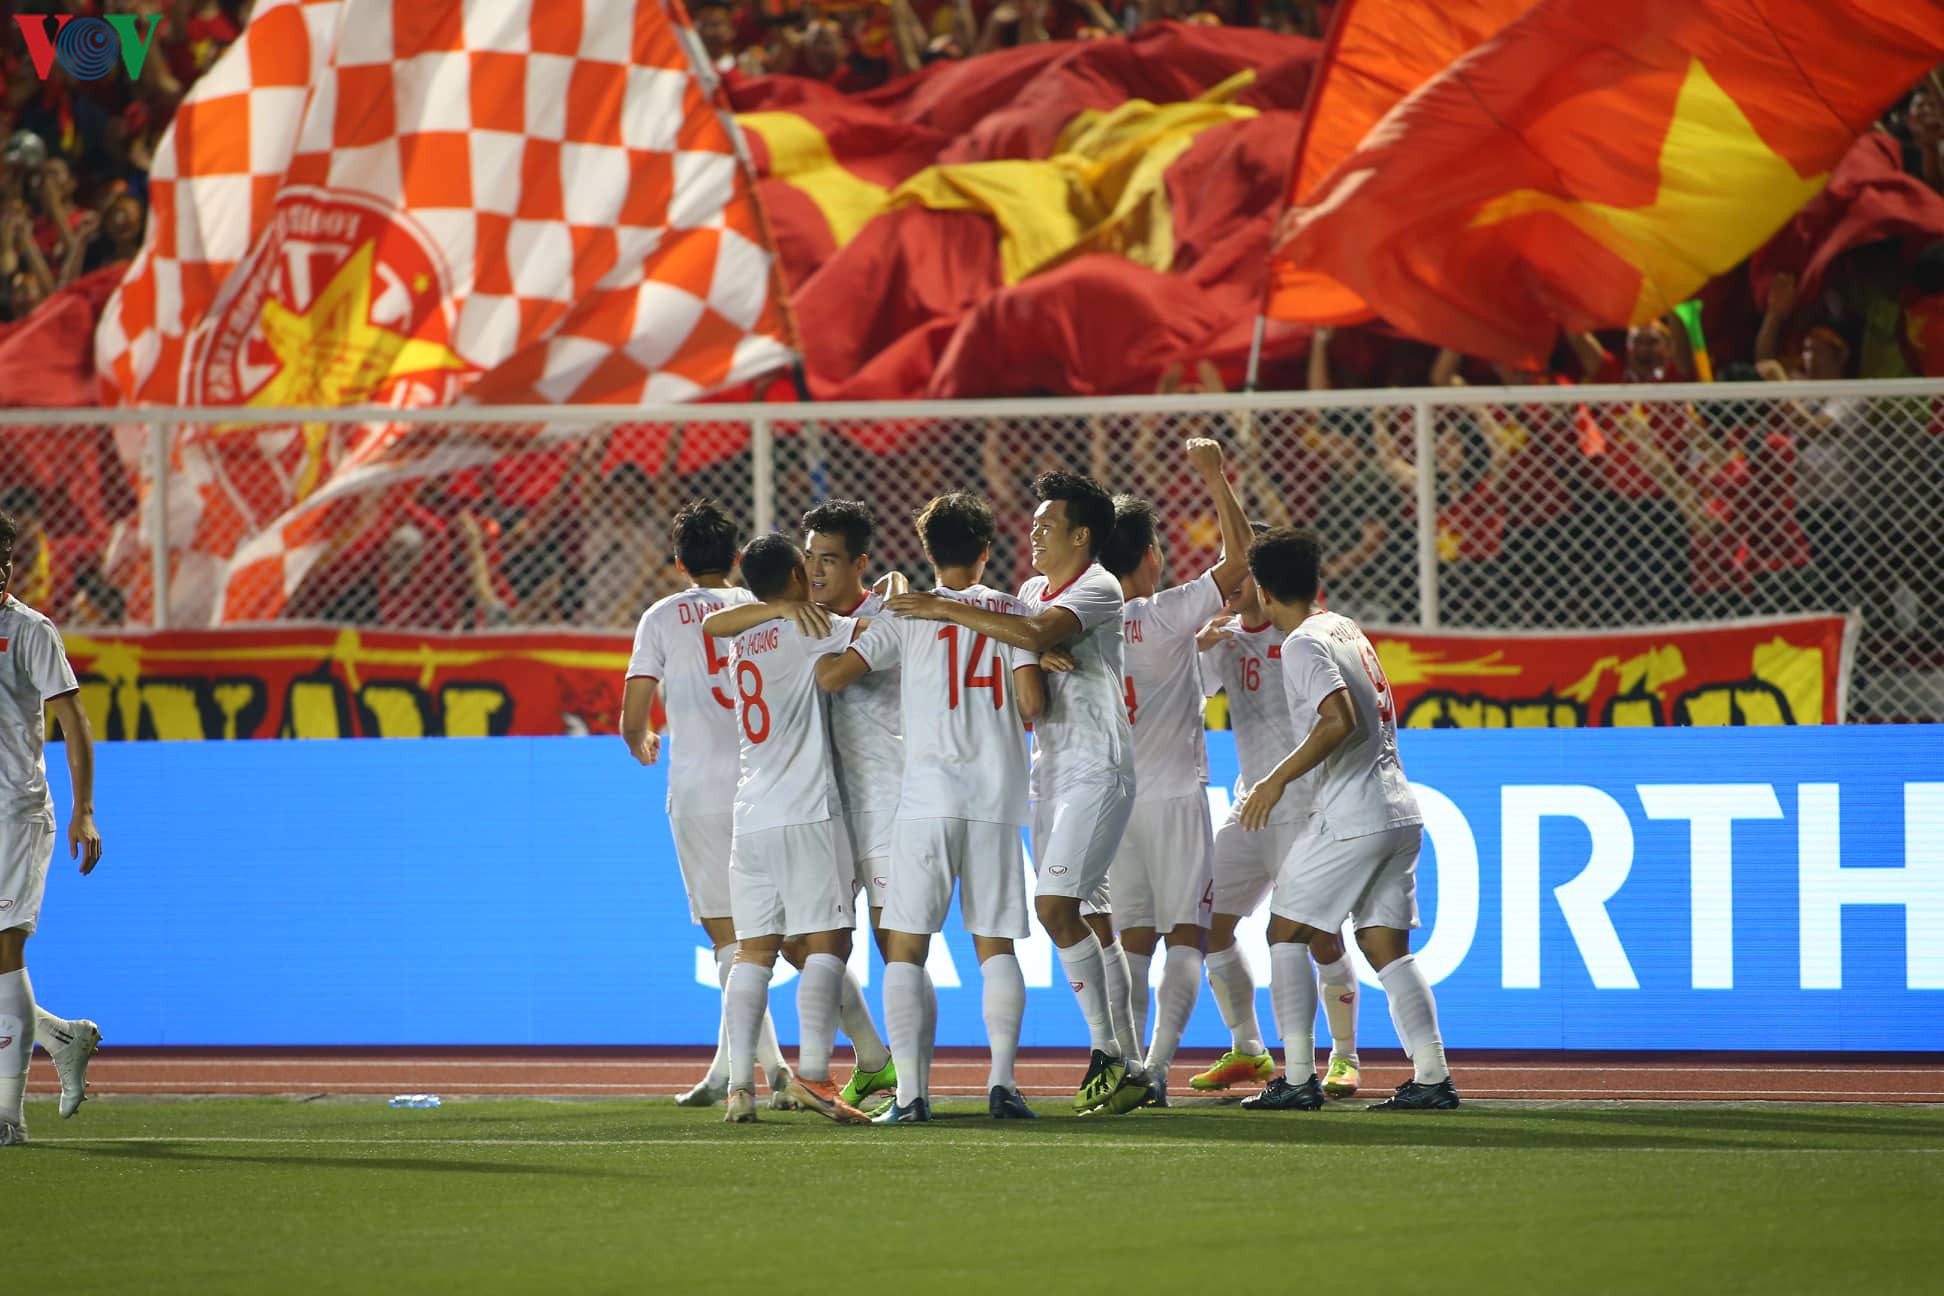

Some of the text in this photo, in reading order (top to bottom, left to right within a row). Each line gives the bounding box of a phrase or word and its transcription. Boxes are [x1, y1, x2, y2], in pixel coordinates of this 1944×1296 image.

[736, 660, 770, 745] 8
[937, 624, 1004, 711] 14
[1239, 656, 1262, 692] 16
